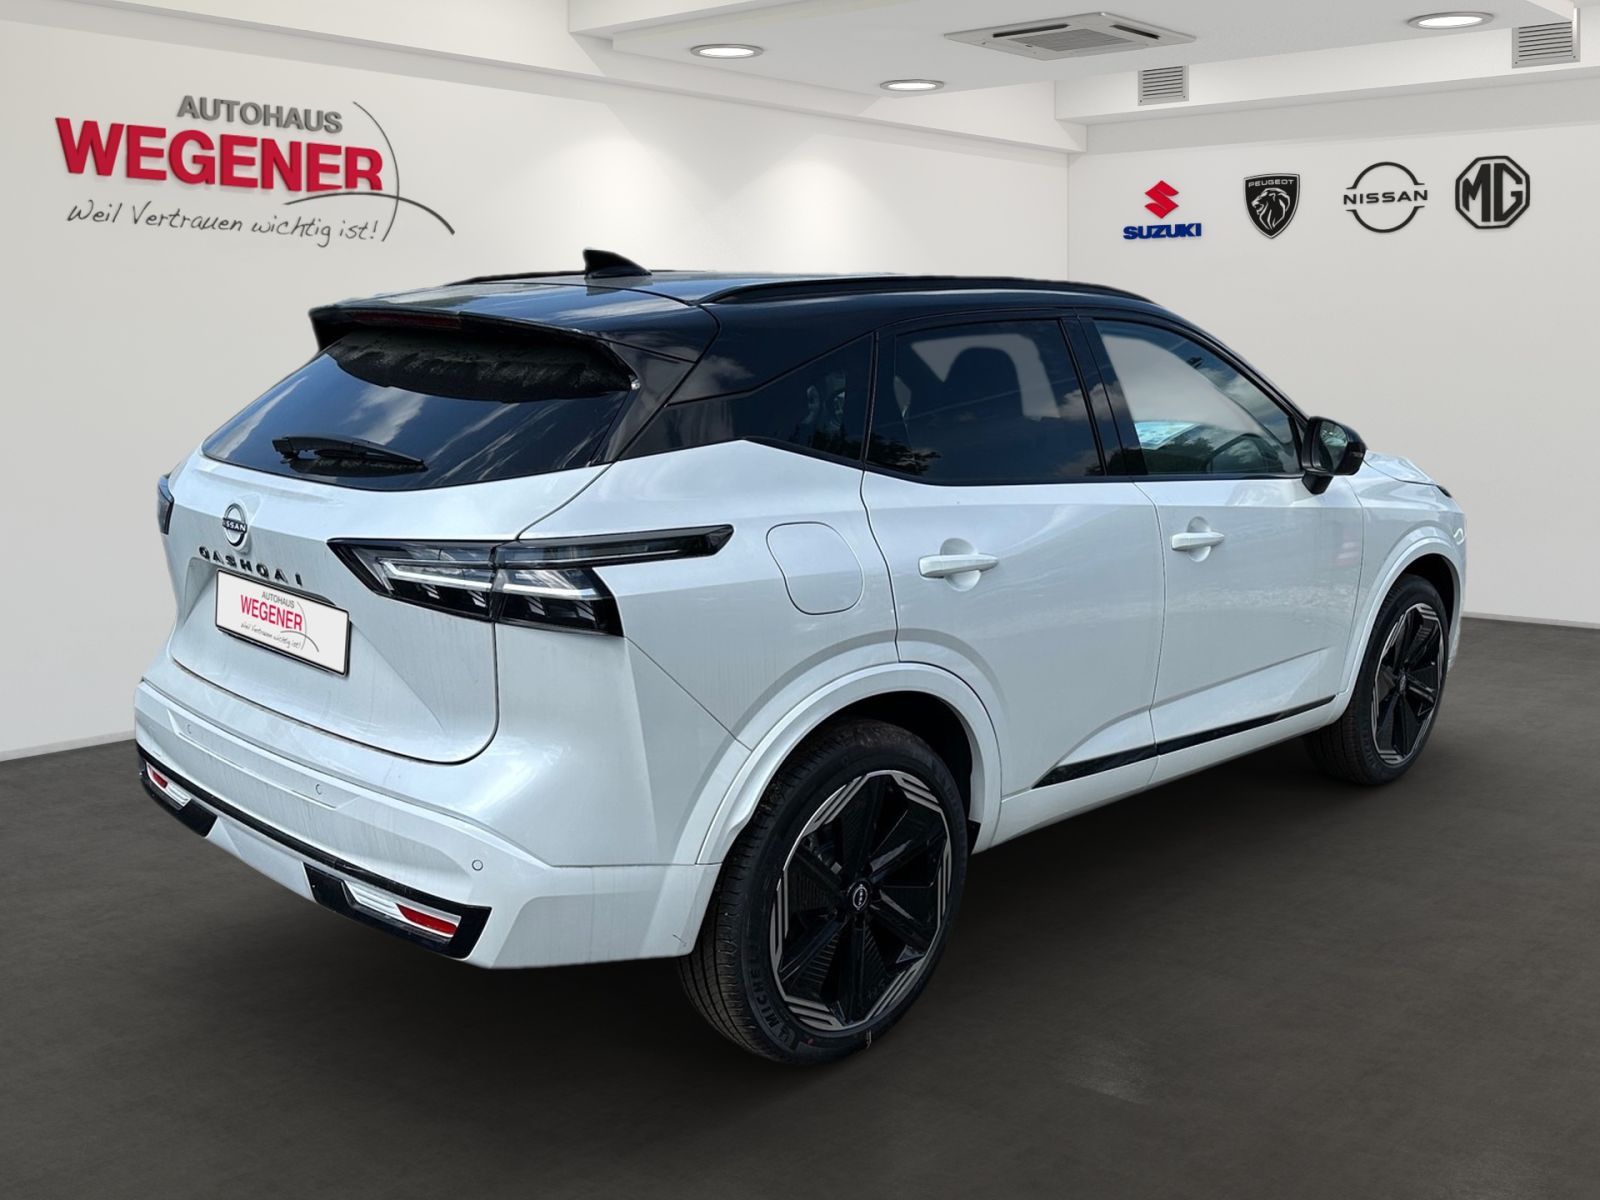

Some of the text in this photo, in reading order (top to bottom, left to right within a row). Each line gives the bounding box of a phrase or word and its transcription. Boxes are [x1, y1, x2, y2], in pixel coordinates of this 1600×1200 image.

[177, 95, 343, 133] AUTOHAUS
[55, 117, 384, 192] WEGENER
[1248, 178, 1295, 188] PEUGEOT
[1343, 189, 1429, 206] NISSAN
[1461, 162, 1524, 223] MG
[66, 200, 380, 248] Weil Vertrauen wichtig ist!
[1122, 222, 1202, 240] SUZUKI
[222, 518, 246, 532] SSAN
[198, 546, 303, 587] QASHQAI
[240, 594, 303, 631] WEGENER
[261, 591, 295, 609] AUTOHAUS
